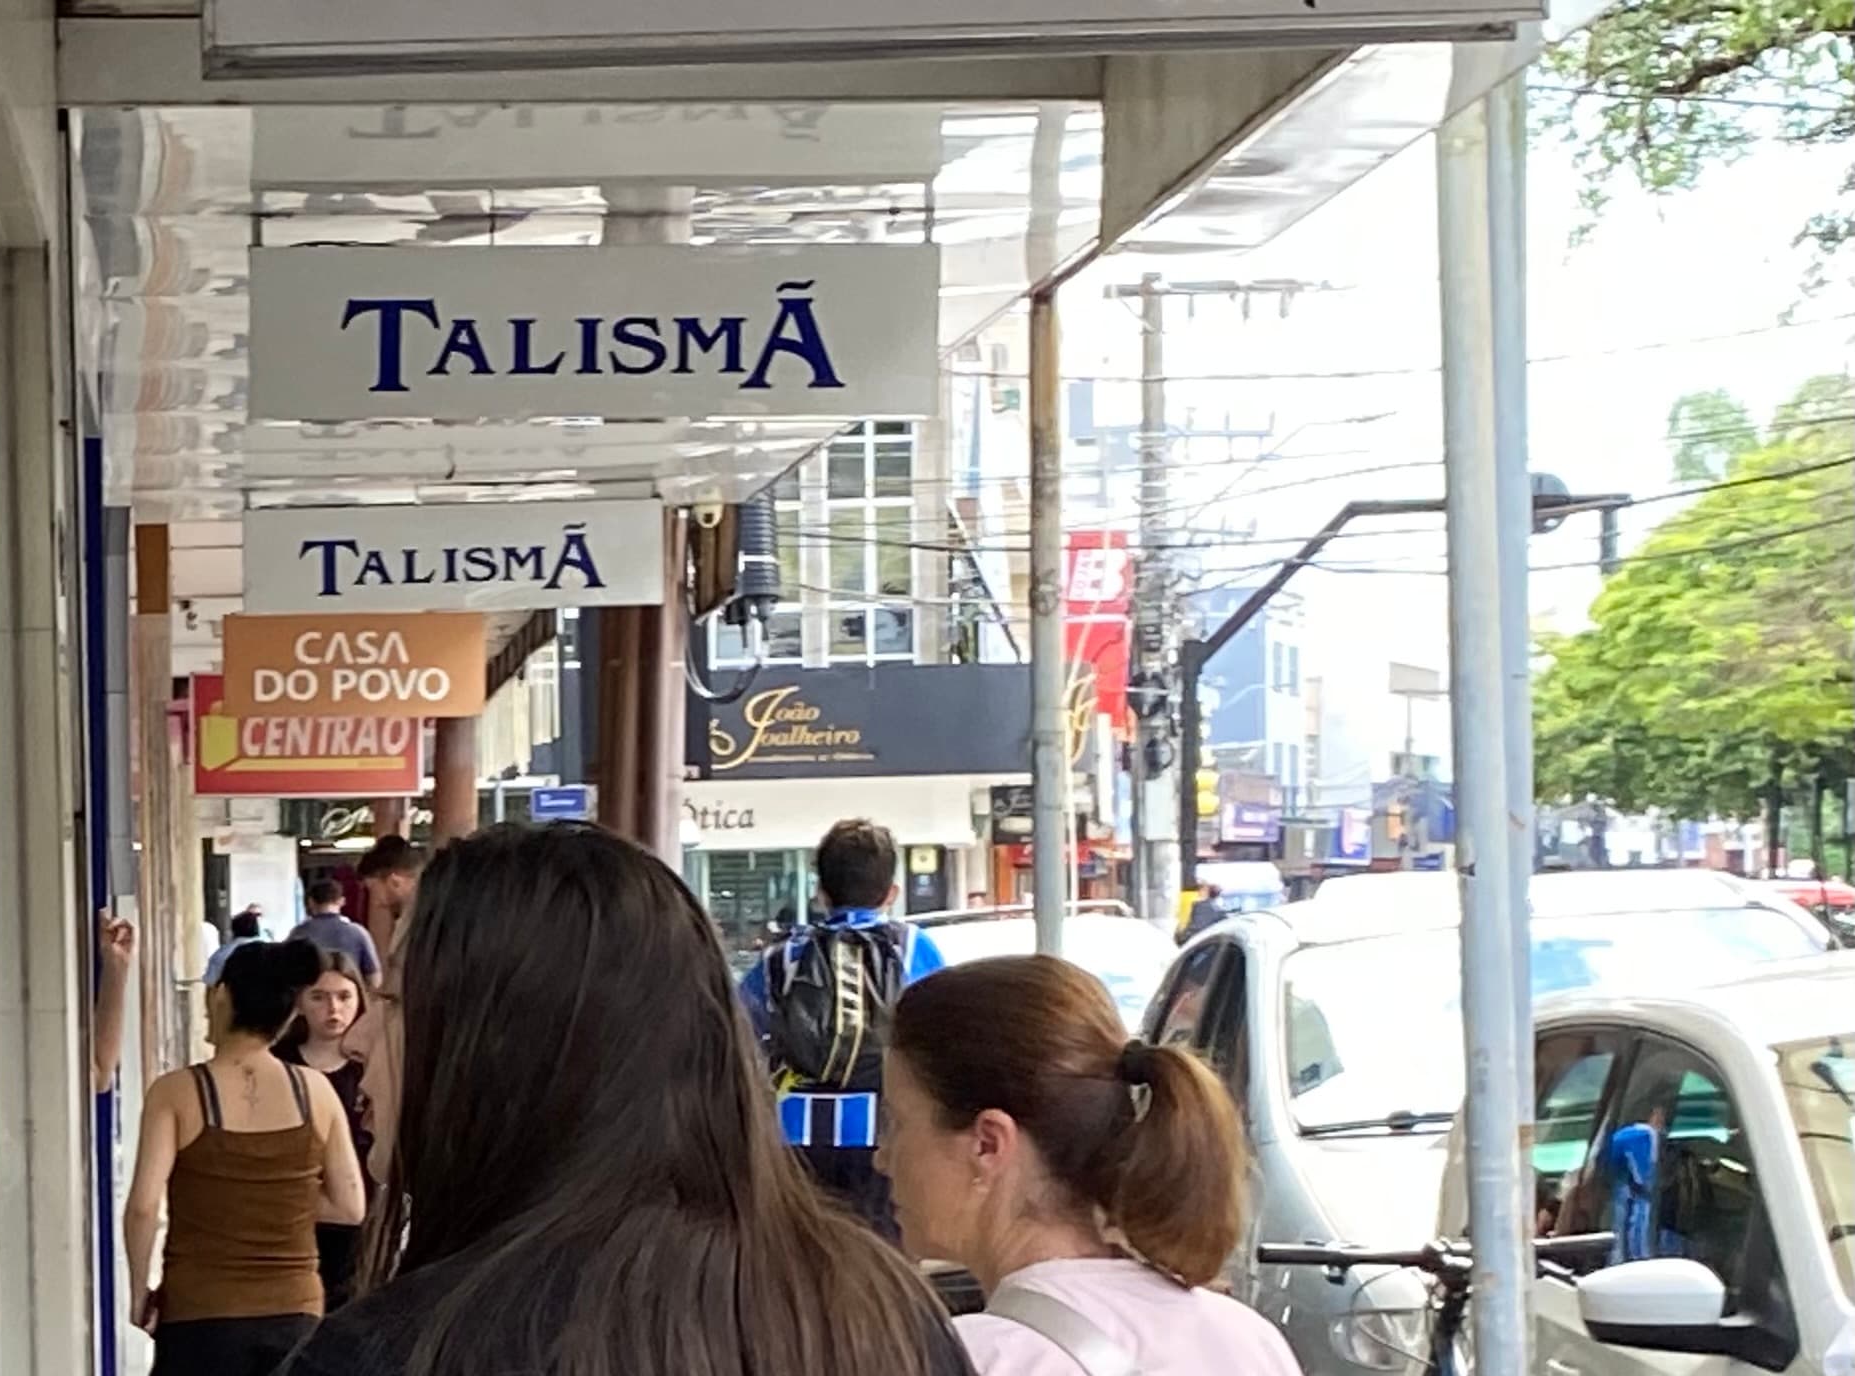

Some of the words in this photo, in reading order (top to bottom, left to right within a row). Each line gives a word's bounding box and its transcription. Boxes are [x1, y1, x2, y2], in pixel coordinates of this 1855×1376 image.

[340, 279, 846, 392] TALISMÃ
[298, 522, 607, 597] TALISMÃ
[295, 631, 410, 665] CASA
[253, 669, 319, 702] DO
[331, 668, 451, 702] POVO
